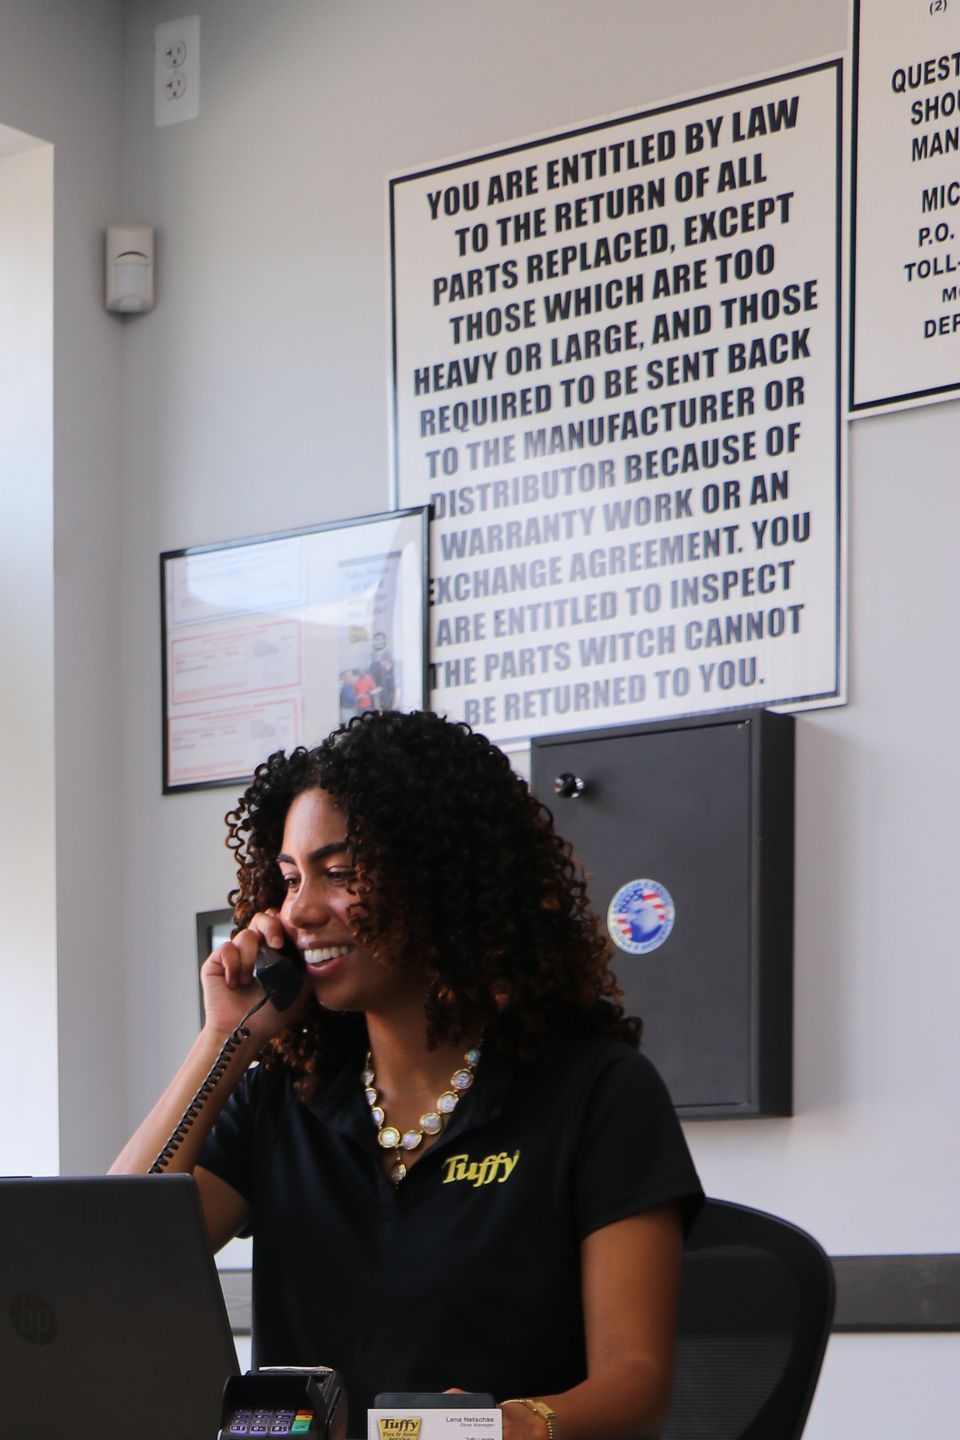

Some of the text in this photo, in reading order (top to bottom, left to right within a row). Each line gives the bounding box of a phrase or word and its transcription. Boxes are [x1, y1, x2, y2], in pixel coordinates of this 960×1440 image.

[910, 90, 960, 126] SHO
[912, 126, 960, 162] MAN
[427, 96, 799, 220] YOU ARE ENTITLED BY LAW
[434, 192, 794, 306] PARTS REPLACED, EXCEPT
[455, 153, 766, 256] TO THE RETURN OF ALL
[918, 222, 955, 248] P.O.
[414, 280, 817, 395] HEAVY OR LARGE, AND THOSE
[450, 244, 774, 344] THOSE WHICH ARE TOO
[942, 286, 960, 303] M
[421, 328, 810, 435] REQUIRED TO BE SENT BACK
[426, 376, 804, 478] TO THE MANUFACTURER OR
[430, 422, 800, 520] DISTRIBUTOR BECAUSE OF
[440, 470, 788, 561] WARRANTY WORK OR AN
[428, 557, 562, 606] EXCHANGE
[571, 524, 743, 580] AGREEMENT.
[752, 512, 810, 549] YOU
[436, 560, 795, 647] ARE ENTITLED TO INSPECT
[429, 604, 804, 690] THE PARTS WITCH CANNOT
[464, 656, 764, 726] BE RETURNED TO YOU.
[442, 1149, 520, 1188] Tuffy
[380, 1418, 419, 1432] Tuffy
